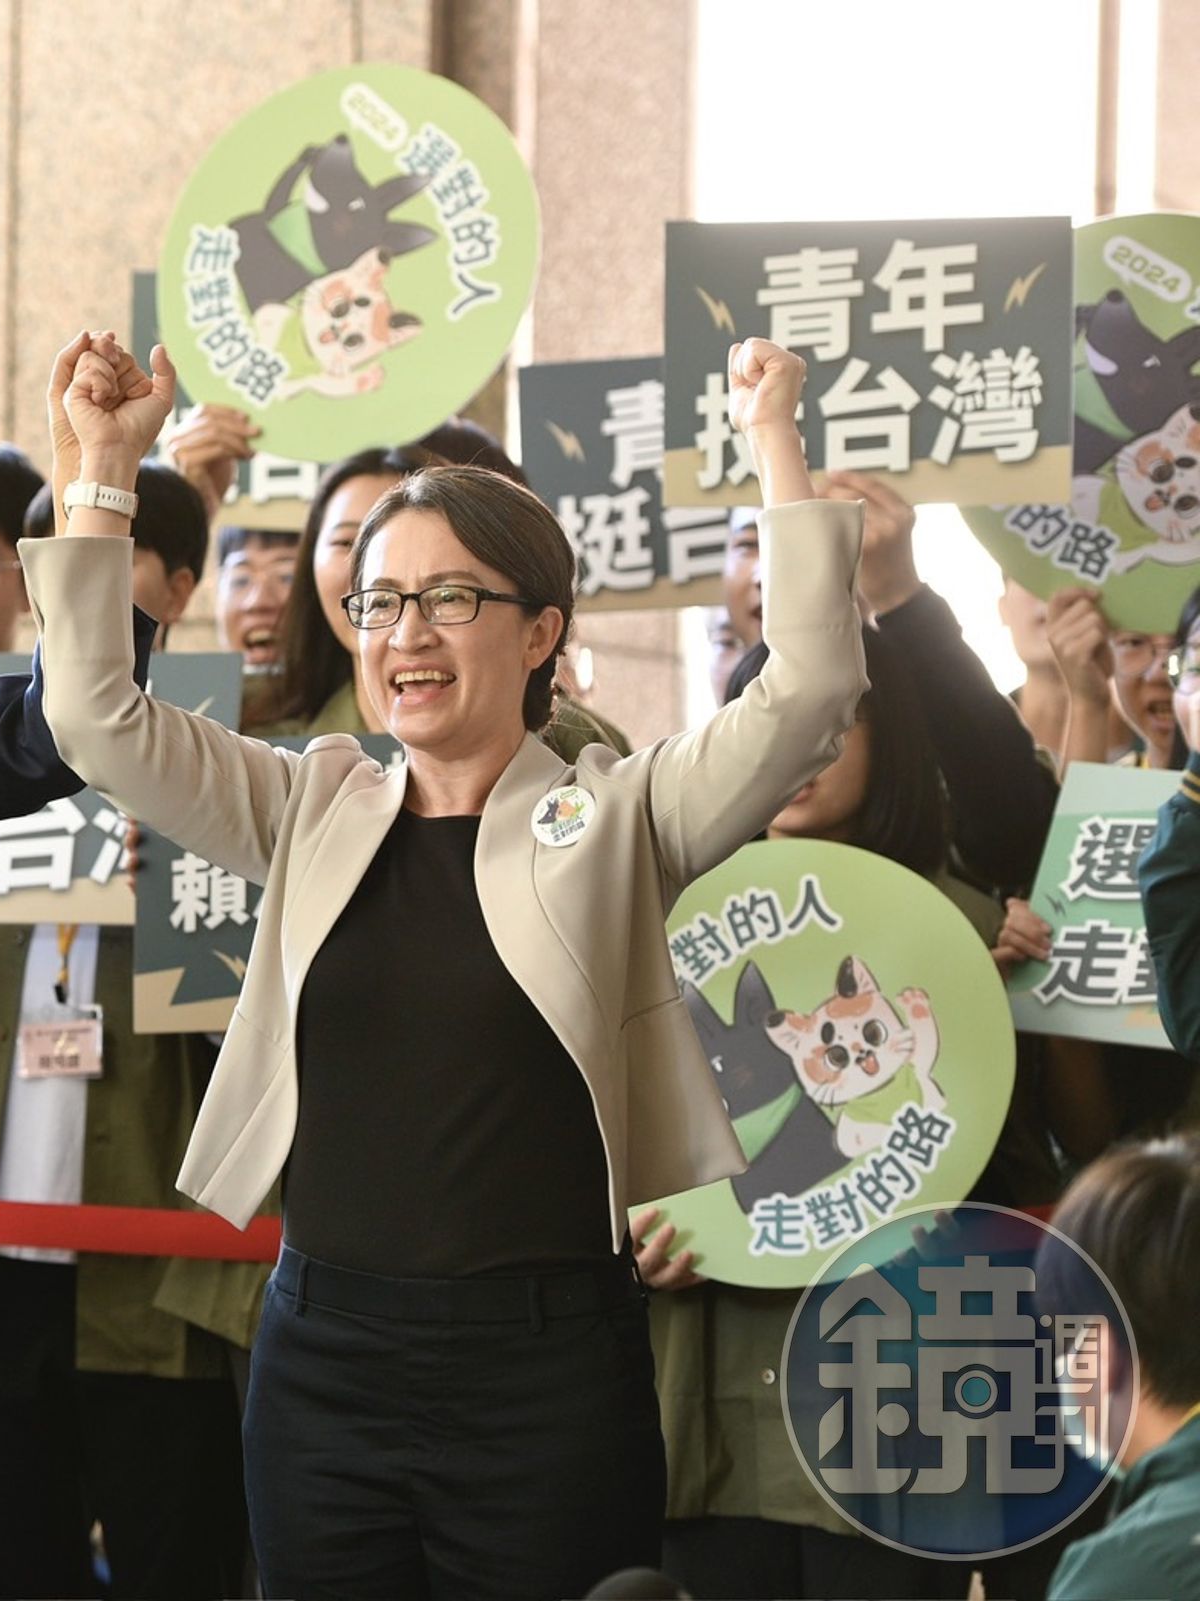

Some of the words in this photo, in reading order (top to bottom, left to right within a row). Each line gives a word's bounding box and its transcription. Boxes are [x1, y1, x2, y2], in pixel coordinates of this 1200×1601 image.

[188, 230, 284, 402] 走對的路
[756, 238, 985, 362] 青年
[1110, 244, 1182, 294] 2024
[669, 879, 838, 985] 對的人
[753, 1107, 952, 1251] 走對的路
